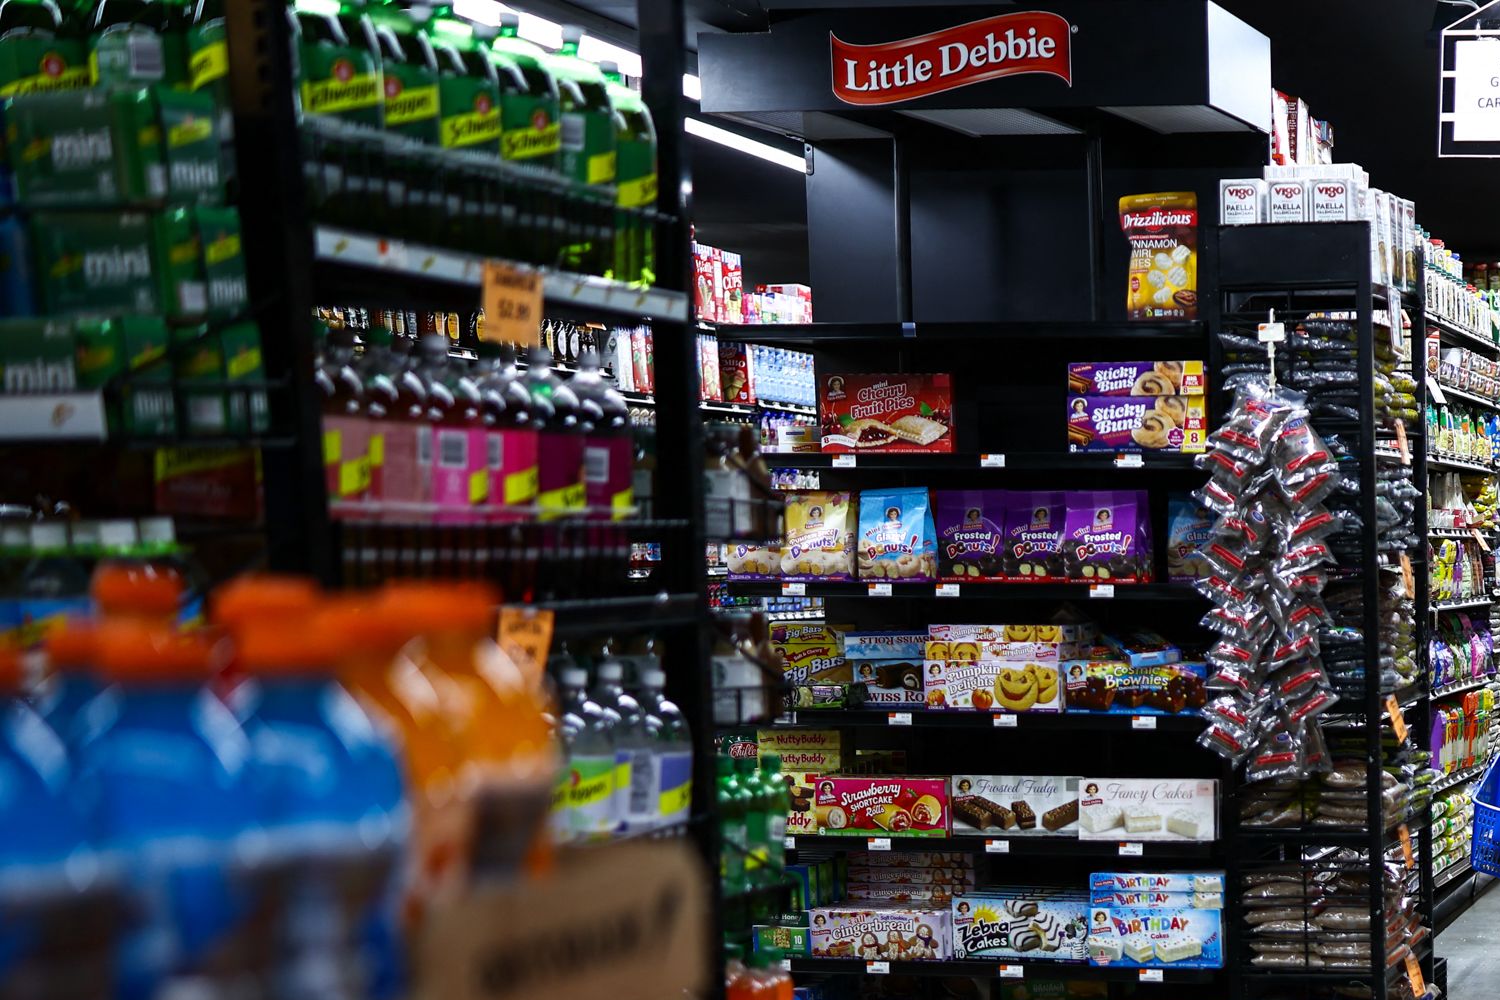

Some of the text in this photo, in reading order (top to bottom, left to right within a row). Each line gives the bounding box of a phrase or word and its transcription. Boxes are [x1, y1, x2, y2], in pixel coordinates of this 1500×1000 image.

[844, 27, 1056, 92] Little Debbie
[1124, 212, 1191, 229] Drizzilicious
[1132, 249, 1154, 258] WIRL
[1094, 366, 1137, 382] Sticky
[858, 383, 907, 402] Cherry
[1097, 378, 1135, 393] Buns
[851, 397, 915, 419] Fruit Pies
[1092, 403, 1146, 423] Sticky
[1095, 416, 1143, 434] Buns
[1190, 433, 1198, 443] 8
[865, 525, 881, 538] Mini
[944, 525, 961, 537] Mini
[954, 531, 992, 541] Frosted
[1011, 524, 1029, 536] Mini
[1021, 531, 1059, 541] Frosted
[1073, 525, 1091, 538] Mini
[1084, 532, 1122, 542] Frosted
[785, 629, 800, 639] Fig
[802, 625, 822, 634] Bars
[951, 626, 1003, 641] Pumpkin Delights
[860, 636, 894, 645] ROLLS
[784, 657, 845, 682] Fig Bars
[946, 664, 1001, 682] Pumpkin
[949, 676, 995, 695] Delights
[1104, 674, 1169, 689] Brownies
[868, 691, 900, 703] WISS
[777, 736, 826, 745] Nutty Buddy
[728, 742, 758, 758] Chifle
[801, 755, 826, 764] Buddy
[841, 783, 901, 806] Strawberry
[976, 779, 1058, 799] Frosted Fudge
[1106, 783, 1194, 802] Fancy Cakes
[851, 796, 893, 813] SHORTCAKE
[866, 806, 885, 817] Rolls
[819, 828, 826, 836] 6
[781, 914, 802, 922] Honey
[832, 919, 914, 940] Gingerbread
[959, 919, 1011, 943] Zebra
[794, 935, 802, 944] 10
[967, 937, 1008, 952] Cakes
[954, 949, 966, 959] 10
